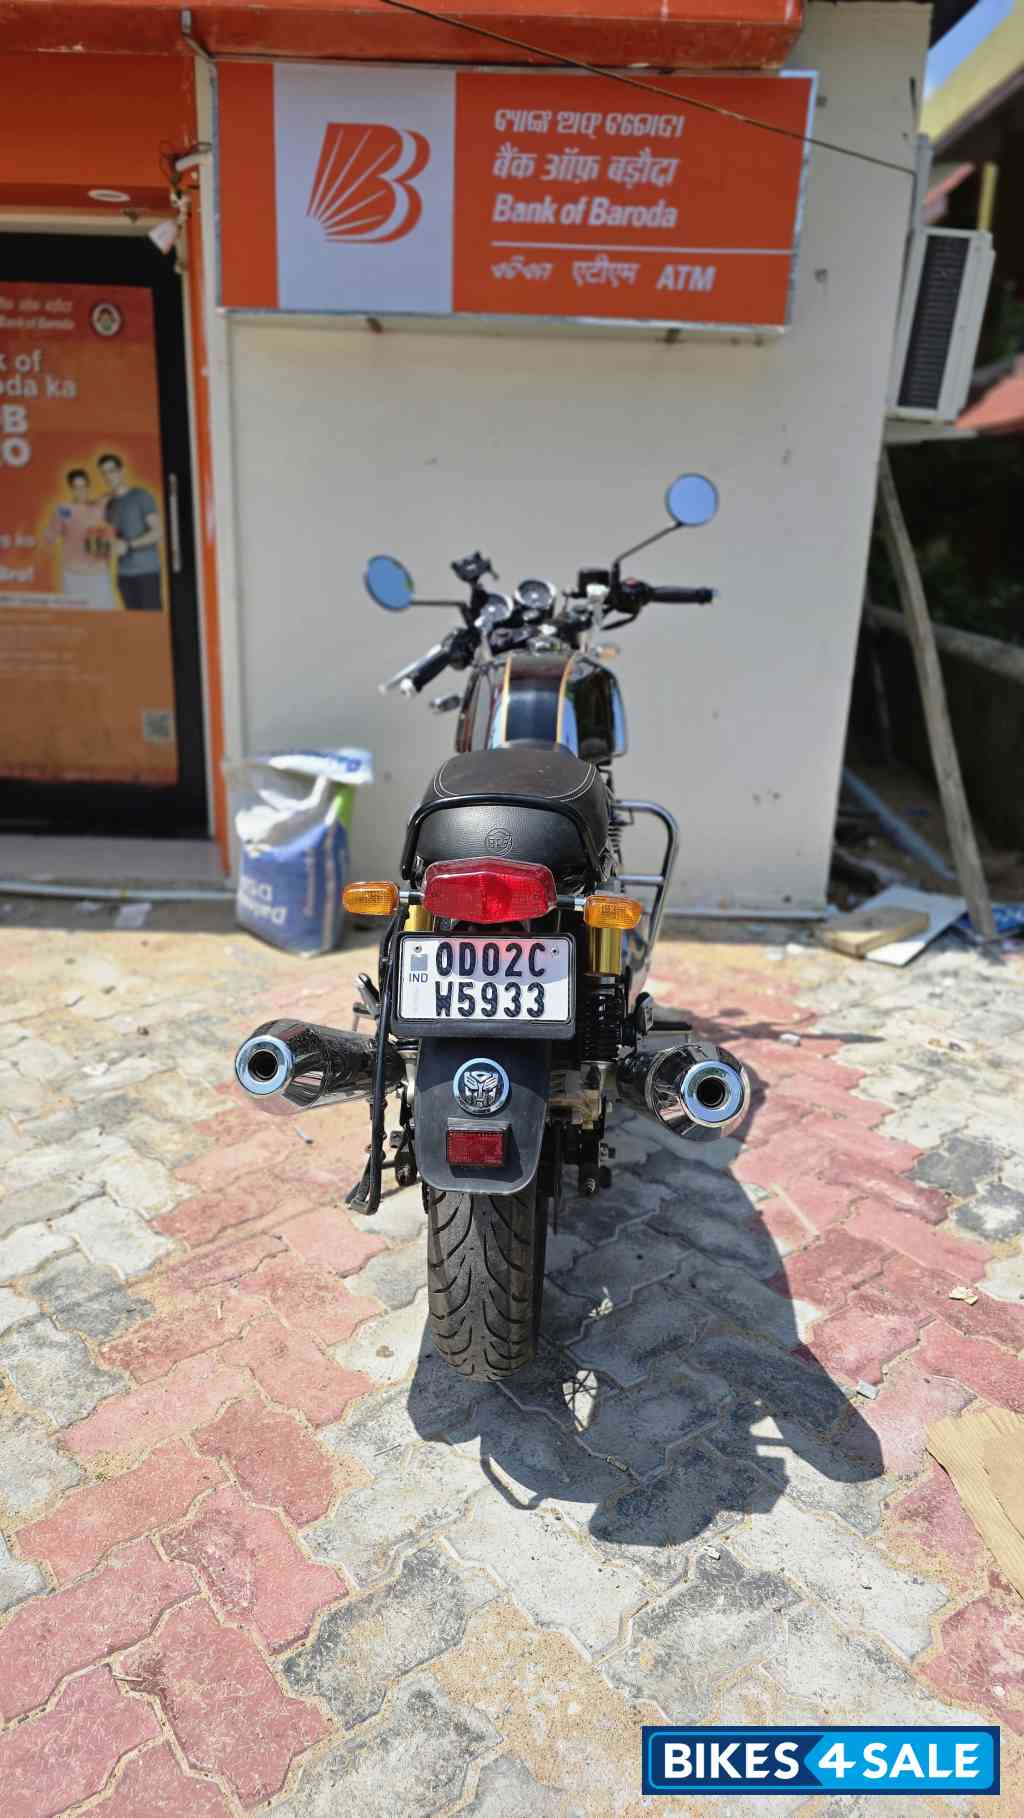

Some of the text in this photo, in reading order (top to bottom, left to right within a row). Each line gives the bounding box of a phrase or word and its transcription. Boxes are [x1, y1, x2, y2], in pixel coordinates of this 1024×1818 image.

[492, 142, 537, 180] बैंक
[492, 193, 678, 229] Bank of Baroda
[655, 264, 717, 293] ATM
[15, 350, 43, 373] of
[46, 376, 77, 399] ka
[408, 972, 429, 983] IND
[435, 981, 546, 1018] W5933
